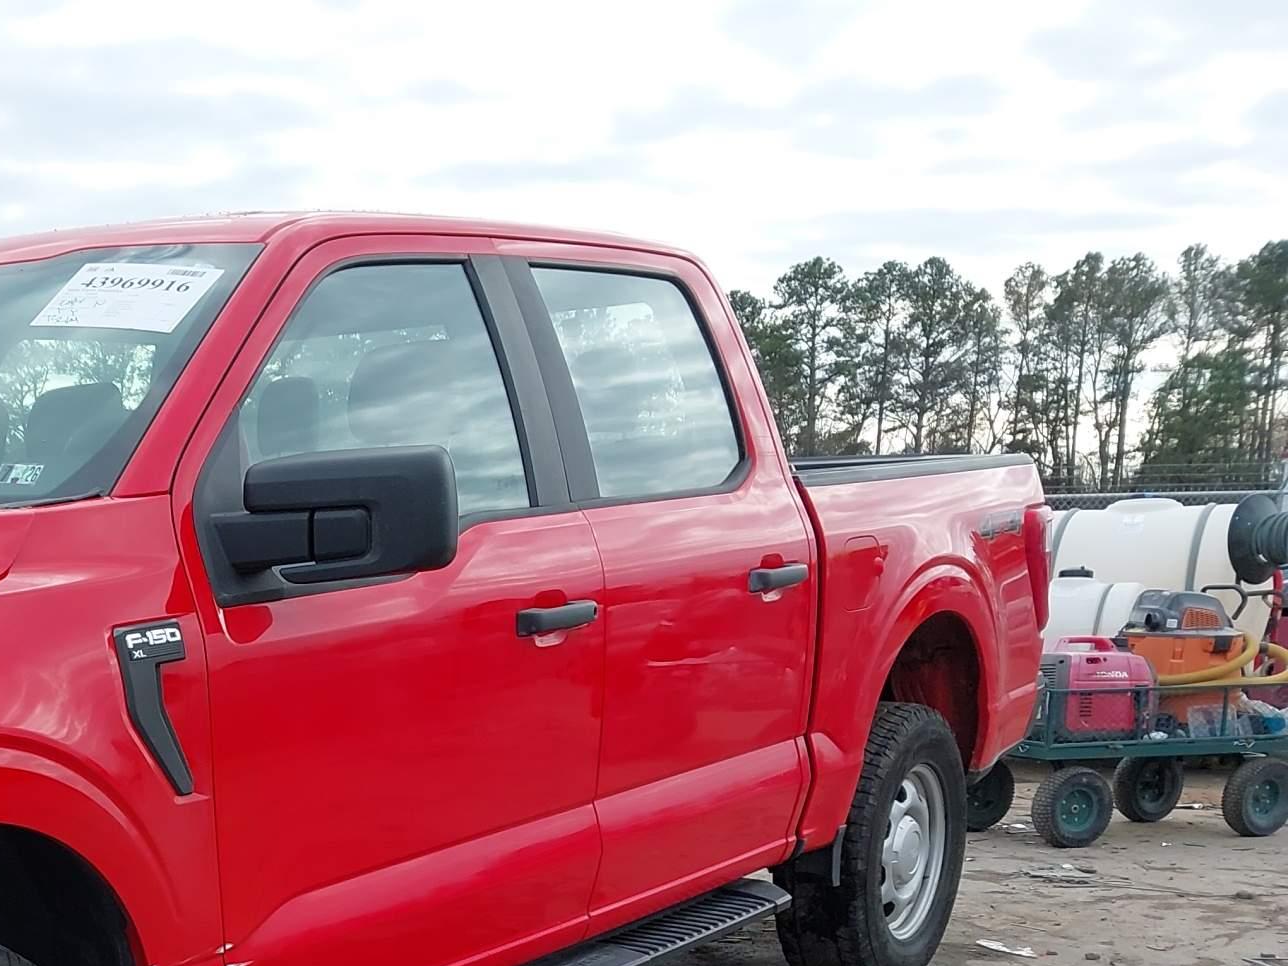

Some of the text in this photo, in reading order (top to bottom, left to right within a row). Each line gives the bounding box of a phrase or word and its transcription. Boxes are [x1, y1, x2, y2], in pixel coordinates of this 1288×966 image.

[80, 277, 191, 292] 43969916
[125, 627, 182, 649] F-150
[132, 649, 147, 659] XL
